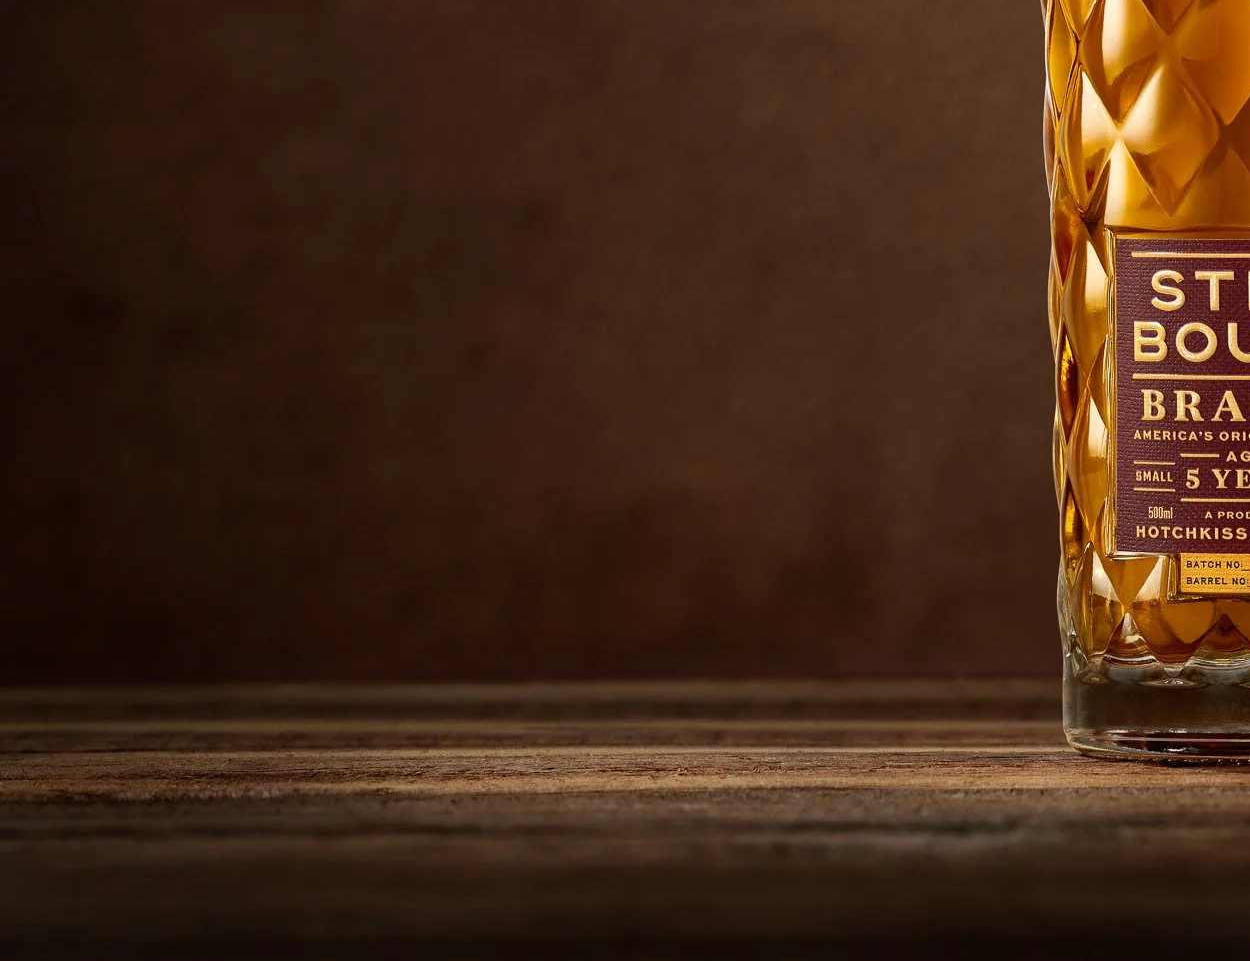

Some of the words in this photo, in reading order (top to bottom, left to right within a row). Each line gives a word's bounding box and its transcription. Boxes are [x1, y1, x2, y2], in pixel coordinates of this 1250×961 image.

[1133, 430, 1213, 441] AMERICA'S
[1135, 470, 1173, 482] SMALL
[1186, 468, 1200, 489] 5
[1148, 507, 1173, 519] 500ml
[1205, 511, 1213, 520] A
[1186, 560, 1222, 569] BATCH
[1226, 560, 1243, 569] NO:
[1186, 576, 1227, 585] BARREL
[1232, 577, 1249, 585] NO:
